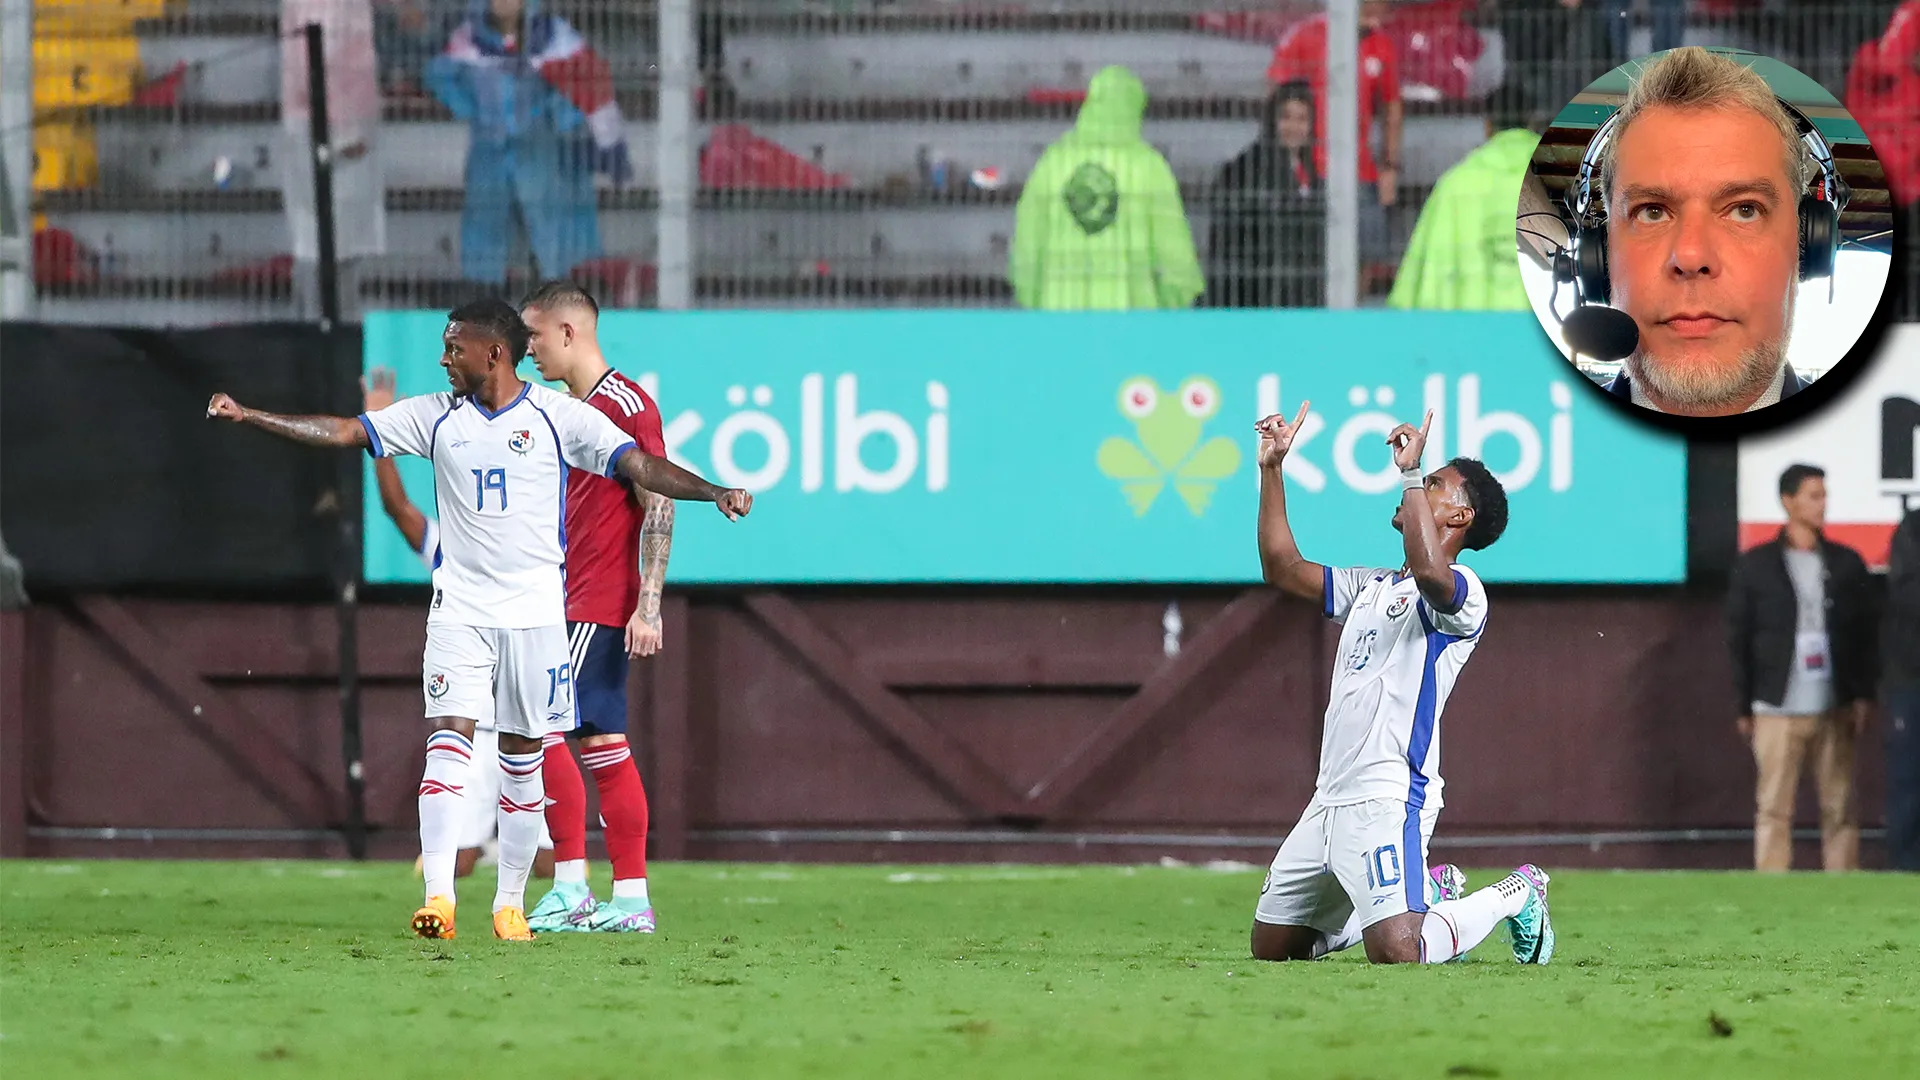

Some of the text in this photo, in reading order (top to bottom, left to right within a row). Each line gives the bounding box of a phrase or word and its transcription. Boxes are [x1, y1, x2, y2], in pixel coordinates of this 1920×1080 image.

[1257, 372, 1574, 494] kölbi
[471, 468, 507, 512] 19
[546, 662, 570, 708] 19
[1360, 844, 1402, 891] 10
